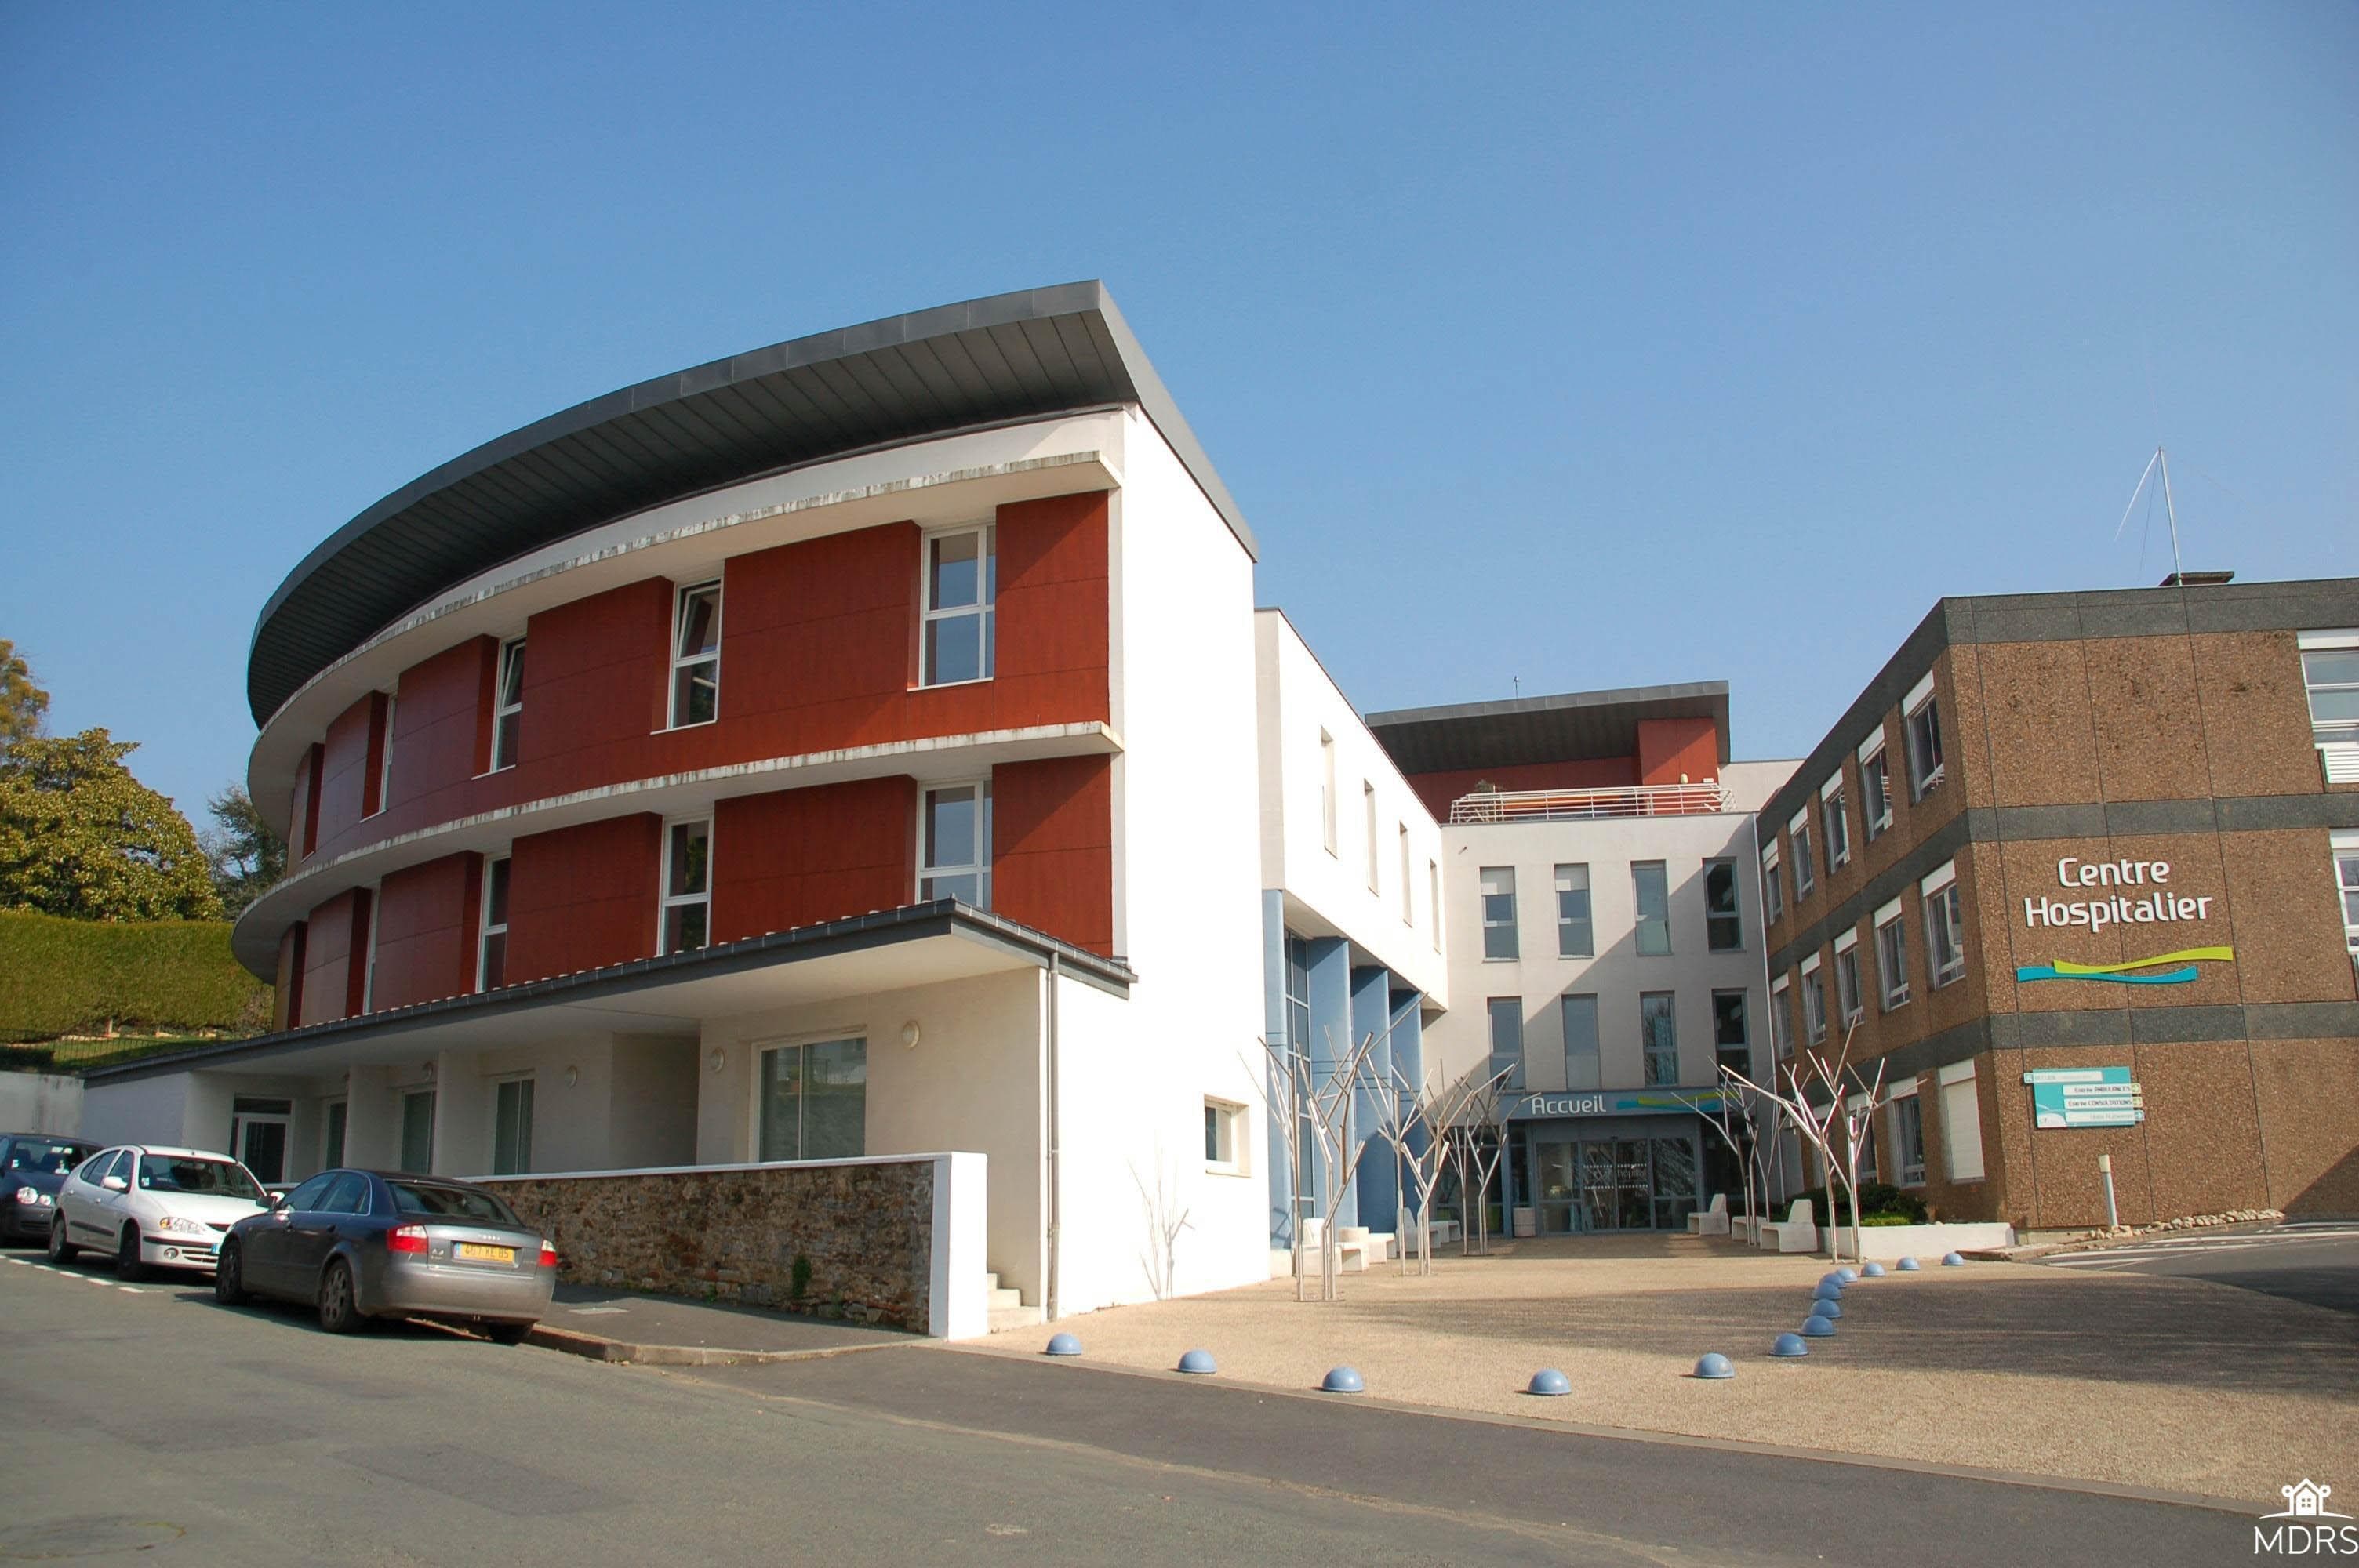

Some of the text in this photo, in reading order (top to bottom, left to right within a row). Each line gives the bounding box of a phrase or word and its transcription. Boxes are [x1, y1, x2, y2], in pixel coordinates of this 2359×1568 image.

[2058, 858, 2170, 887] Centre
[2024, 892, 2212, 933] Hospitalier
[1532, 1094, 1606, 1115] Accueil
